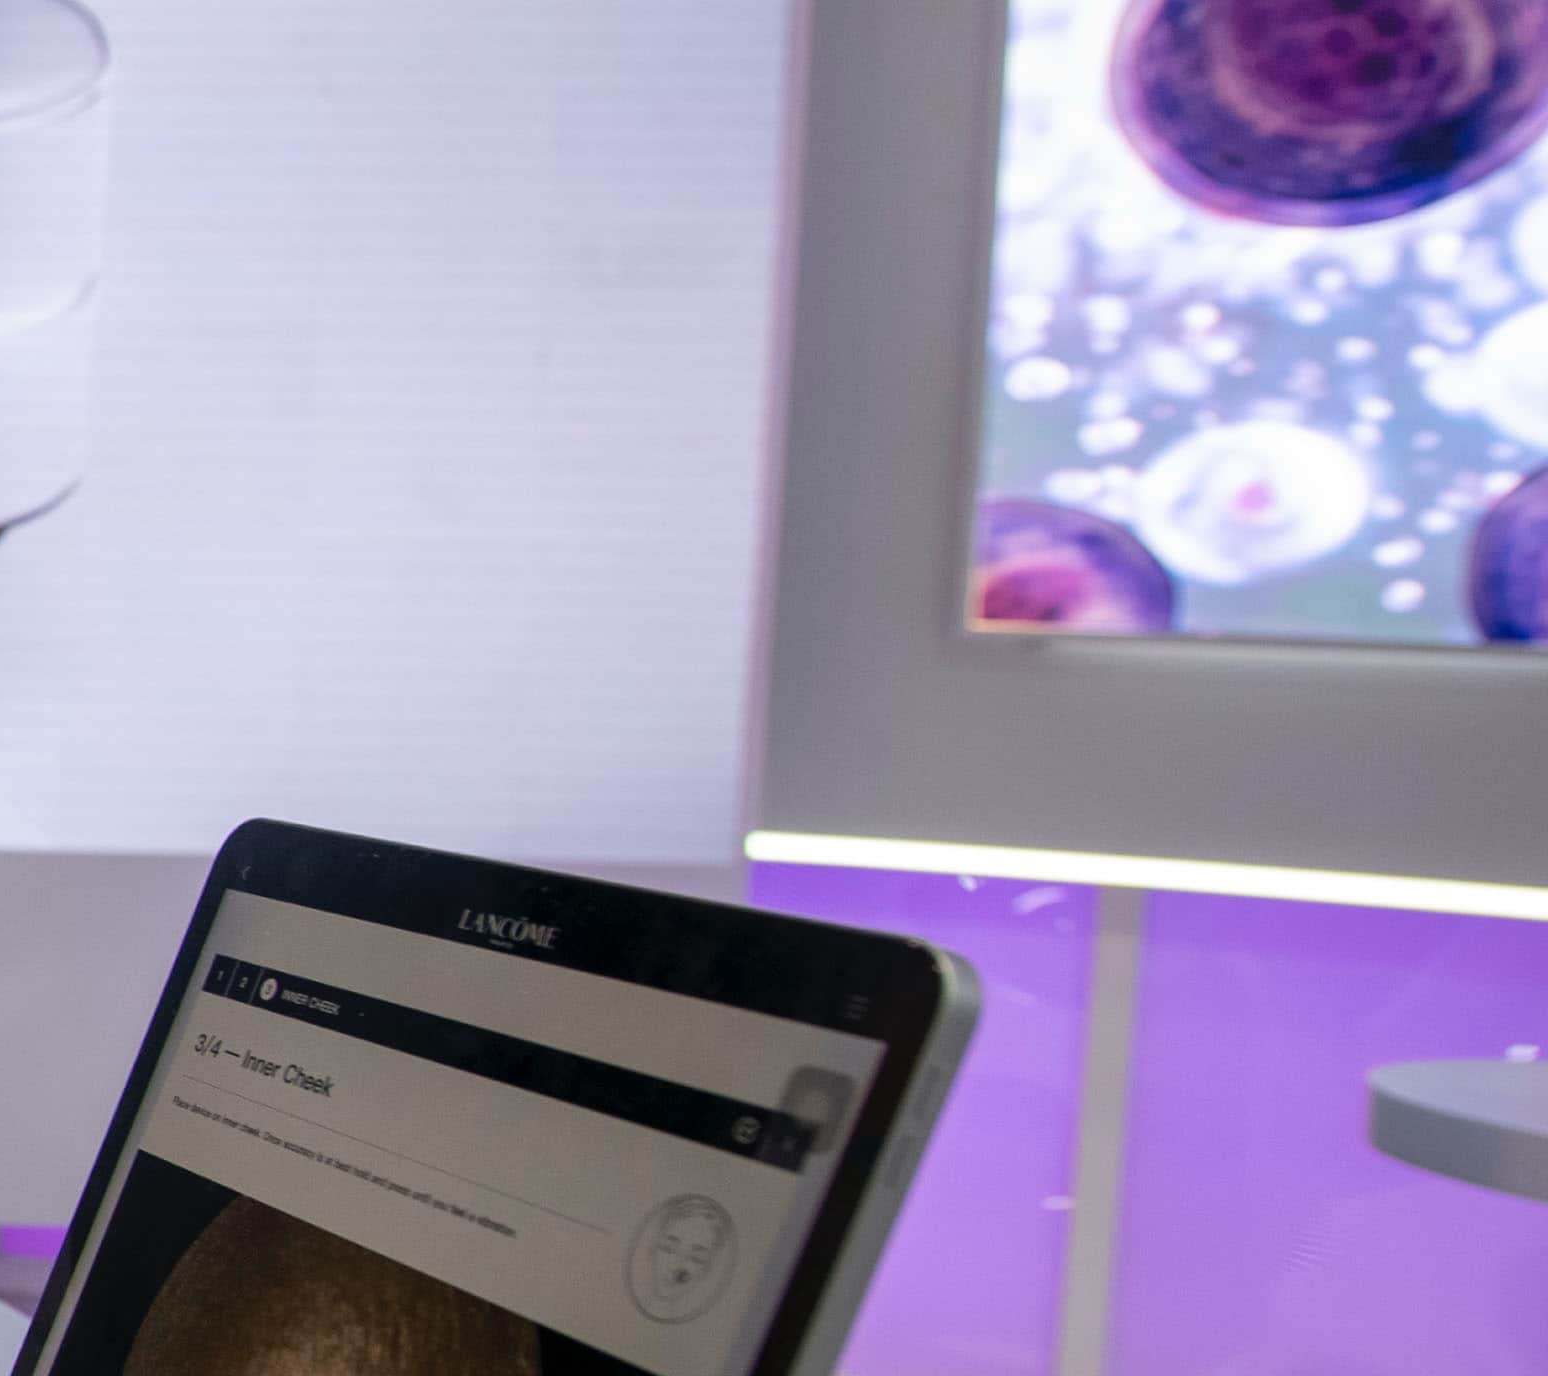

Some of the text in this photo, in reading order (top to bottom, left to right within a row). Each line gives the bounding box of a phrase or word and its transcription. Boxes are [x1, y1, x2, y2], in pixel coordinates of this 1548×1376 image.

[194, 1033, 223, 1059] 3/4
[242, 1049, 282, 1079] Inner
[283, 1063, 335, 1098] Cheek
